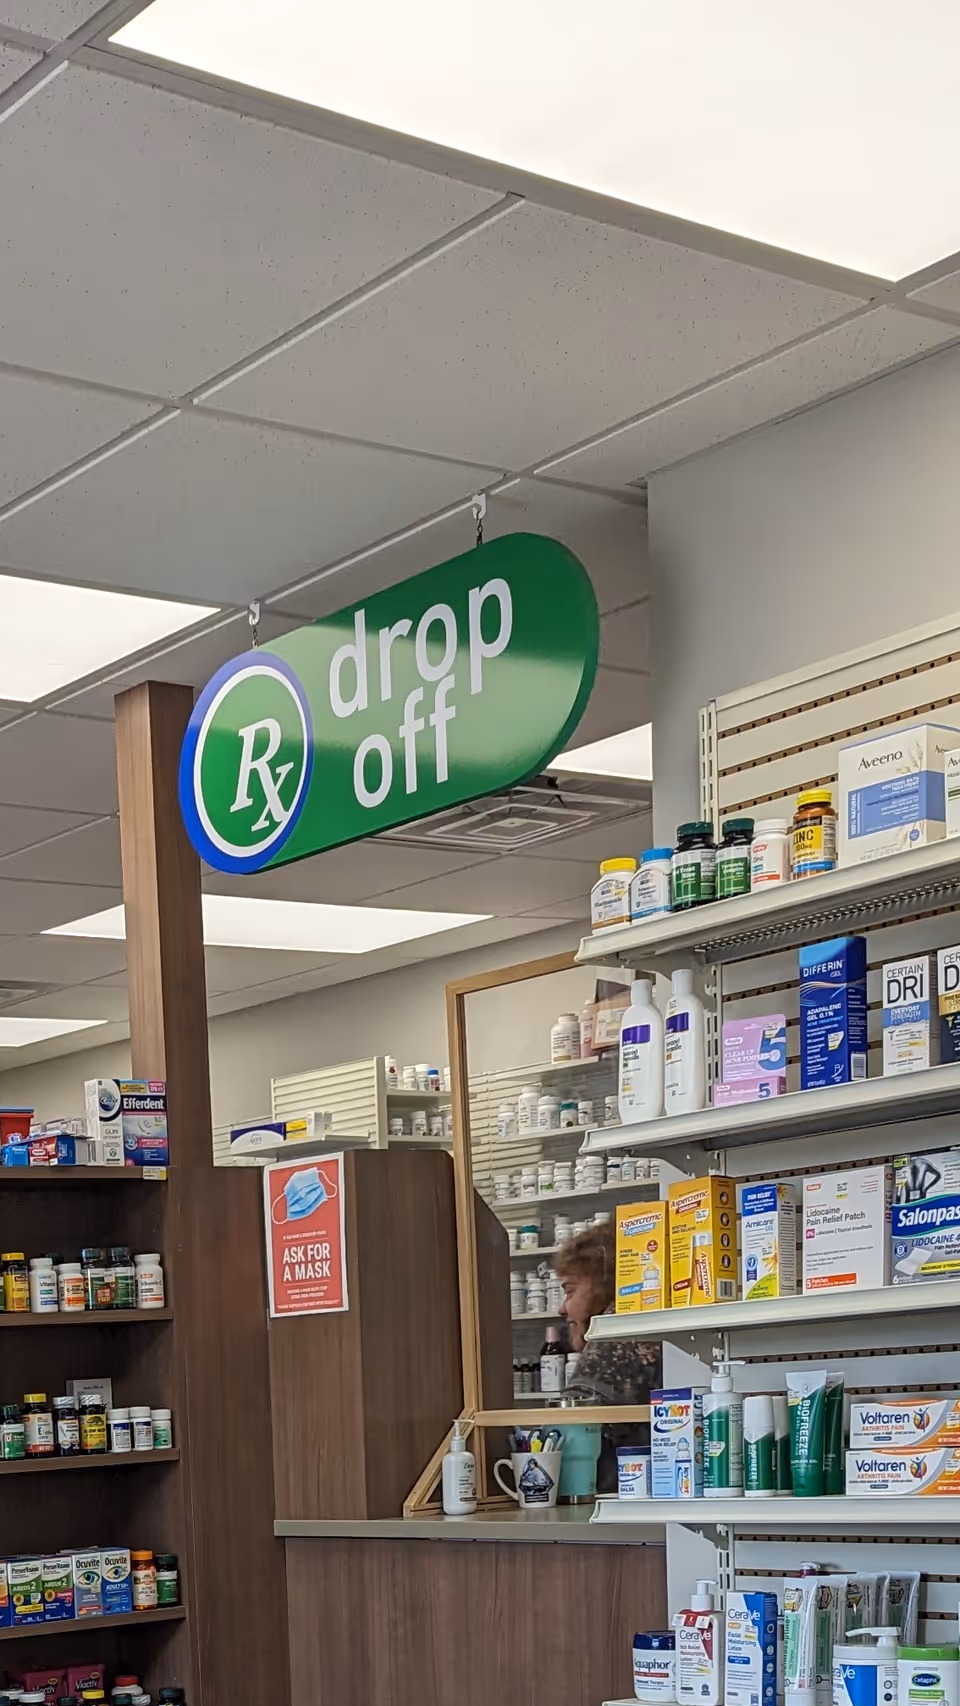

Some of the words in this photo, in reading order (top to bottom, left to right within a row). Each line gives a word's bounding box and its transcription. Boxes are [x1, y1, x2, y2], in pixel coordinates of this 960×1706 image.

[330, 578, 513, 718] drop
[353, 673, 456, 808] off
[858, 751, 903, 771] Aveeno
[230, 718, 294, 833] Rx
[793, 829, 814, 845] ZINC
[803, 961, 843, 977] DIFFERIN
[887, 963, 924, 979] CERTAIN
[887, 974, 924, 1004] DRI
[807, 1003, 841, 1015] ADAPALENE
[890, 1005, 920, 1016] EVERYDAY
[890, 1011, 921, 1020] STRENGTH
[123, 1097, 165, 1109] Efferdent
[670, 1190, 709, 1208] Aspercreme
[806, 1206, 841, 1218] Lidocaine
[806, 1217, 821, 1226] Pain
[823, 1214, 843, 1225] Relief
[845, 1210, 865, 1221] Patch
[897, 1205, 960, 1227] Salonpas
[618, 1214, 663, 1229] Aspercreme
[745, 1219, 774, 1228] Arnicare
[911, 1233, 954, 1247] LIDOCAINE
[283, 1246, 305, 1264] ASK
[307, 1243, 330, 1261] FOR
[283, 1265, 292, 1282] A
[295, 1260, 331, 1280] MASK
[700, 1252, 711, 1299] Aspercreme
[806, 1279, 812, 1288] 5
[860, 1411, 910, 1426] Voltaren
[801, 1399, 809, 1457] BIOFREEZE
[855, 1459, 907, 1474] Voltaren
[43, 1562, 70, 1571] PreserVision
[76, 1559, 100, 1568] Ocuvite
[105, 1557, 127, 1565] Ocuvite
[12, 1566, 40, 1575] PreserVision
[728, 1609, 760, 1621] CeraVe
[680, 1629, 711, 1641] CeraVe
[728, 1639, 757, 1647] Moisturizing
[76, 1679, 98, 1689] Viactiv
